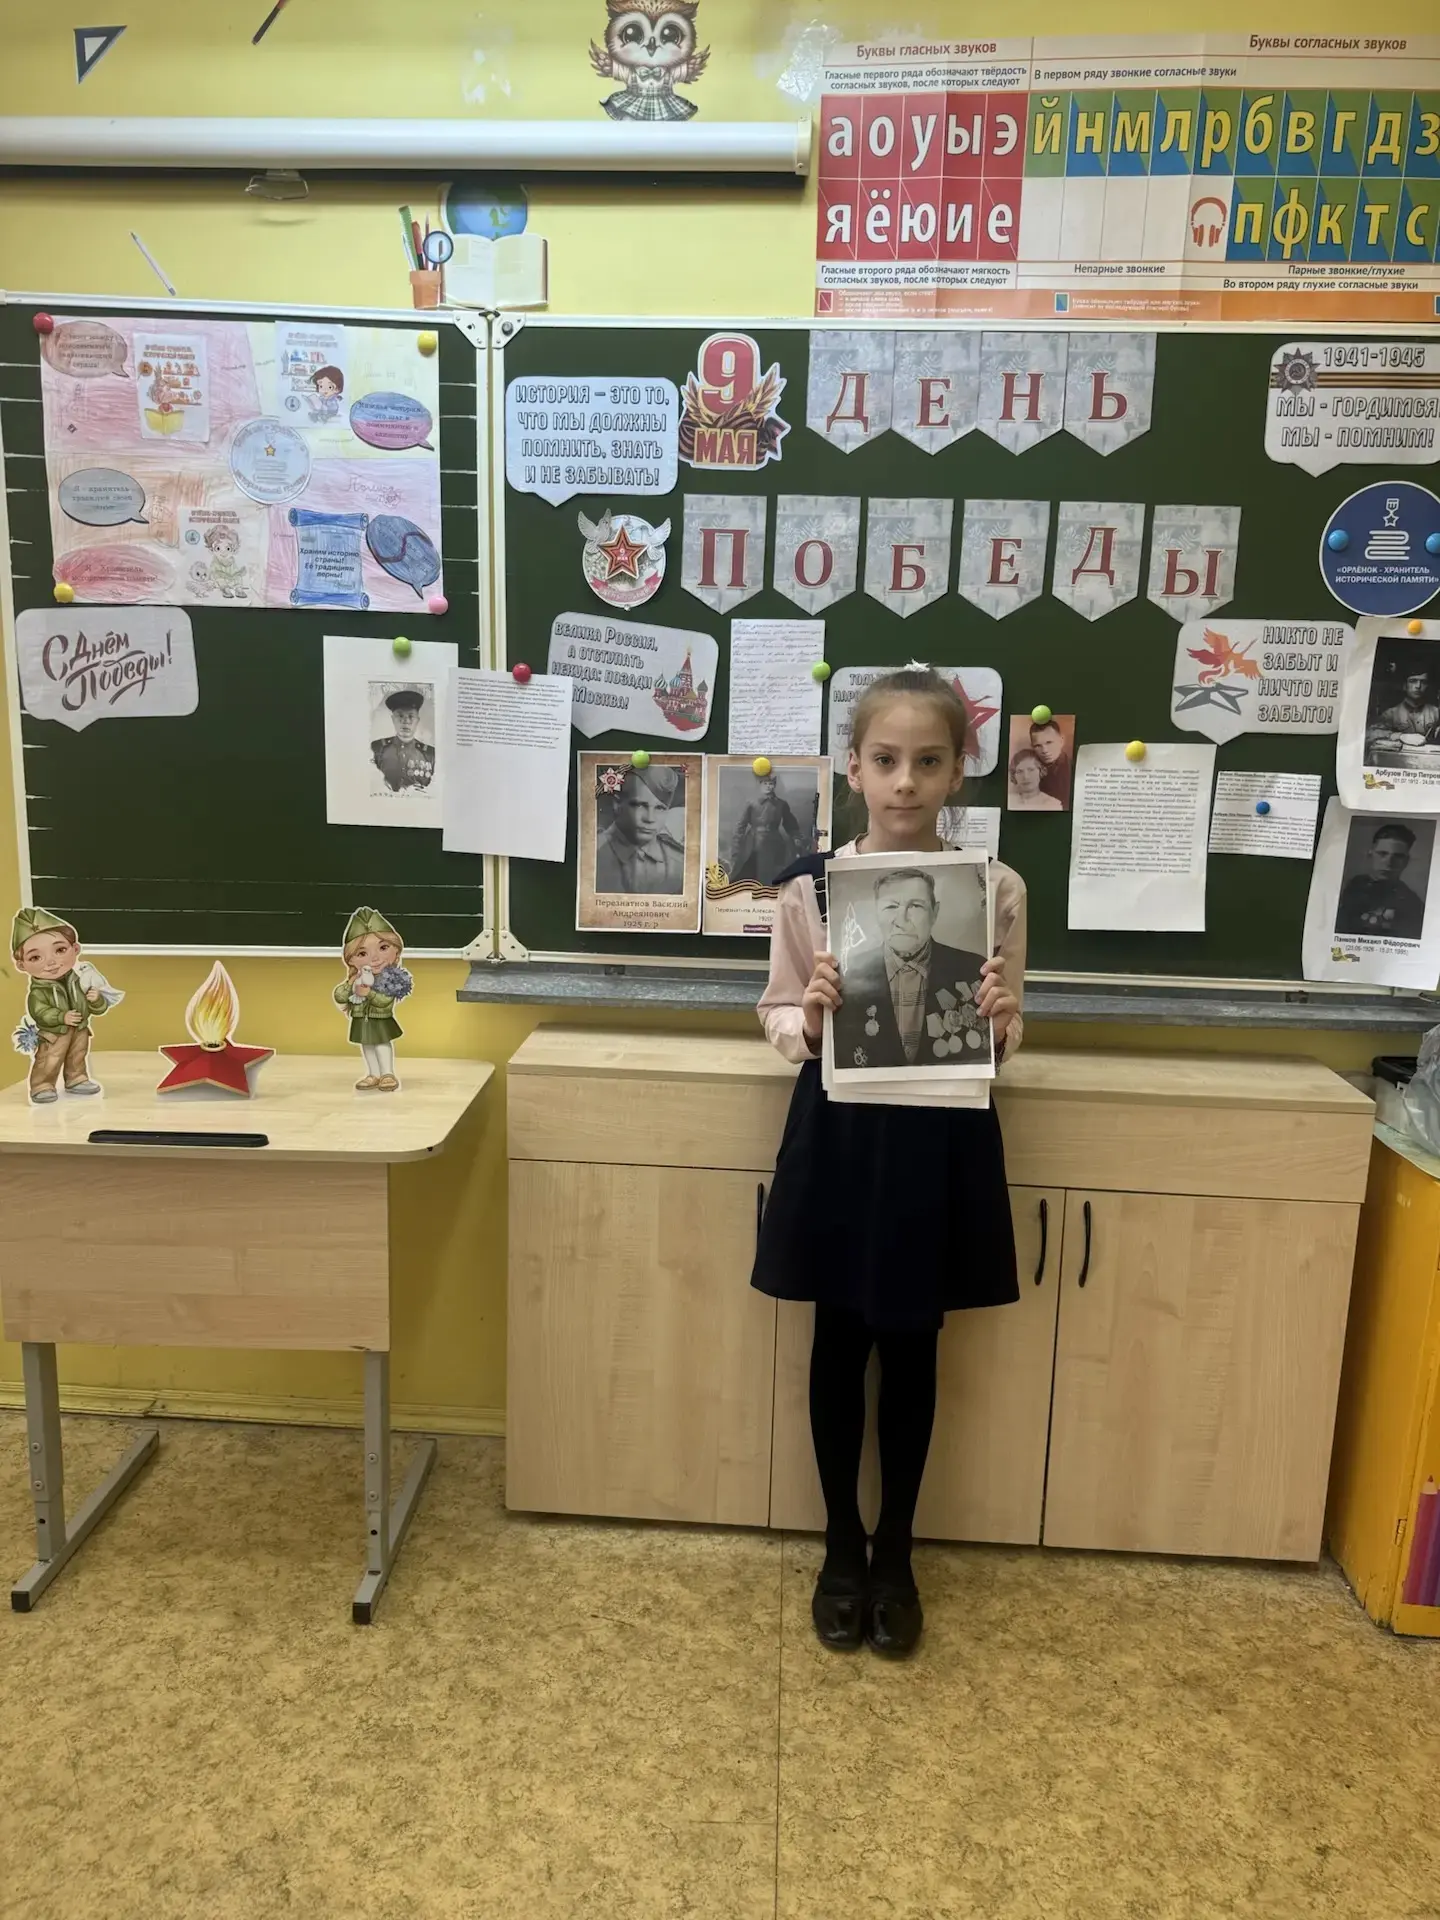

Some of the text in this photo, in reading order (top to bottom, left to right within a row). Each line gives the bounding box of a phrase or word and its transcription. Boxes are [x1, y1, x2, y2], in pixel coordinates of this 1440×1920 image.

[857, 43, 997, 60] Буквы гласных звуков
[1249, 34, 1407, 54] Буквы согласных звуков
[825, 66, 1027, 81] Гласные первого ряда обозначают твёрдость
[1034, 66, 1237, 82] В первом ряду звонкие согласные звуки
[830, 77, 1020, 91] согласных звуков, после которых следуют
[1032, 94, 1440, 169] й н м л р б в г д з
[827, 113, 1019, 172] а о у ы э
[824, 188, 1013, 244] я ё ю и е
[1233, 202, 1265, 244] п
[1273, 187, 1310, 260] ф
[1363, 203, 1391, 246] т
[1405, 203, 1431, 247] с
[821, 265, 1011, 277] Гласные второго ряда обозначают мягкость
[1074, 263, 1166, 275] Непарные звонкие
[1288, 265, 1405, 278] Парные звонкие/глухие
[824, 275, 1007, 286] согласных звуков, после которых следуют
[1223, 279, 1419, 292] Во втором ряду глухие согласные звуки
[1323, 347, 1426, 368] 1941-1945
[697, 336, 756, 416] 9
[515, 385, 591, 405] ИСТОРИЯ
[610, 386, 642, 406] ЭТО
[645, 386, 670, 406] ТО,
[1276, 396, 1315, 417] МЫ
[1332, 396, 1440, 420] ГОРДИМСЯ
[517, 412, 667, 434] ЧТО МЫ ДОЛЖНЫ
[1281, 426, 1320, 447] МЫ
[1336, 427, 1436, 448] ПОМНИМ!
[521, 439, 663, 459] ПОМНИТЬ, ЗНАТЬ
[696, 429, 757, 466] МАЯ
[524, 465, 660, 487] И НЕ ЗАБЫВАТЬ!
[299, 547, 360, 558] Храним историю
[314, 556, 345, 565] страны!
[1335, 575, 1440, 584] ИСТОРИЧЕСКОЙ ПАМЯТИ»
[1336, 565, 1378, 574] «ОРЛЁНОК
[1383, 566, 1430, 574] ХРАНИТЕЛЬ
[1262, 626, 1344, 646] НИКТО НЕ
[41, 629, 130, 682] С Днём
[1262, 652, 1339, 672] ЗАБЫТ И
[61, 629, 174, 711] Победы!
[1257, 678, 1339, 698] НИЧТО НЕ
[1257, 704, 1334, 724] ЗАБЫТО!
[1375, 769, 1402, 778] Арбузов
[612, 909, 670, 919] Андреянович
[652, 899, 689, 909] Василий
[623, 920, 642, 929] 1925
[1357, 937, 1382, 945] Михаил
